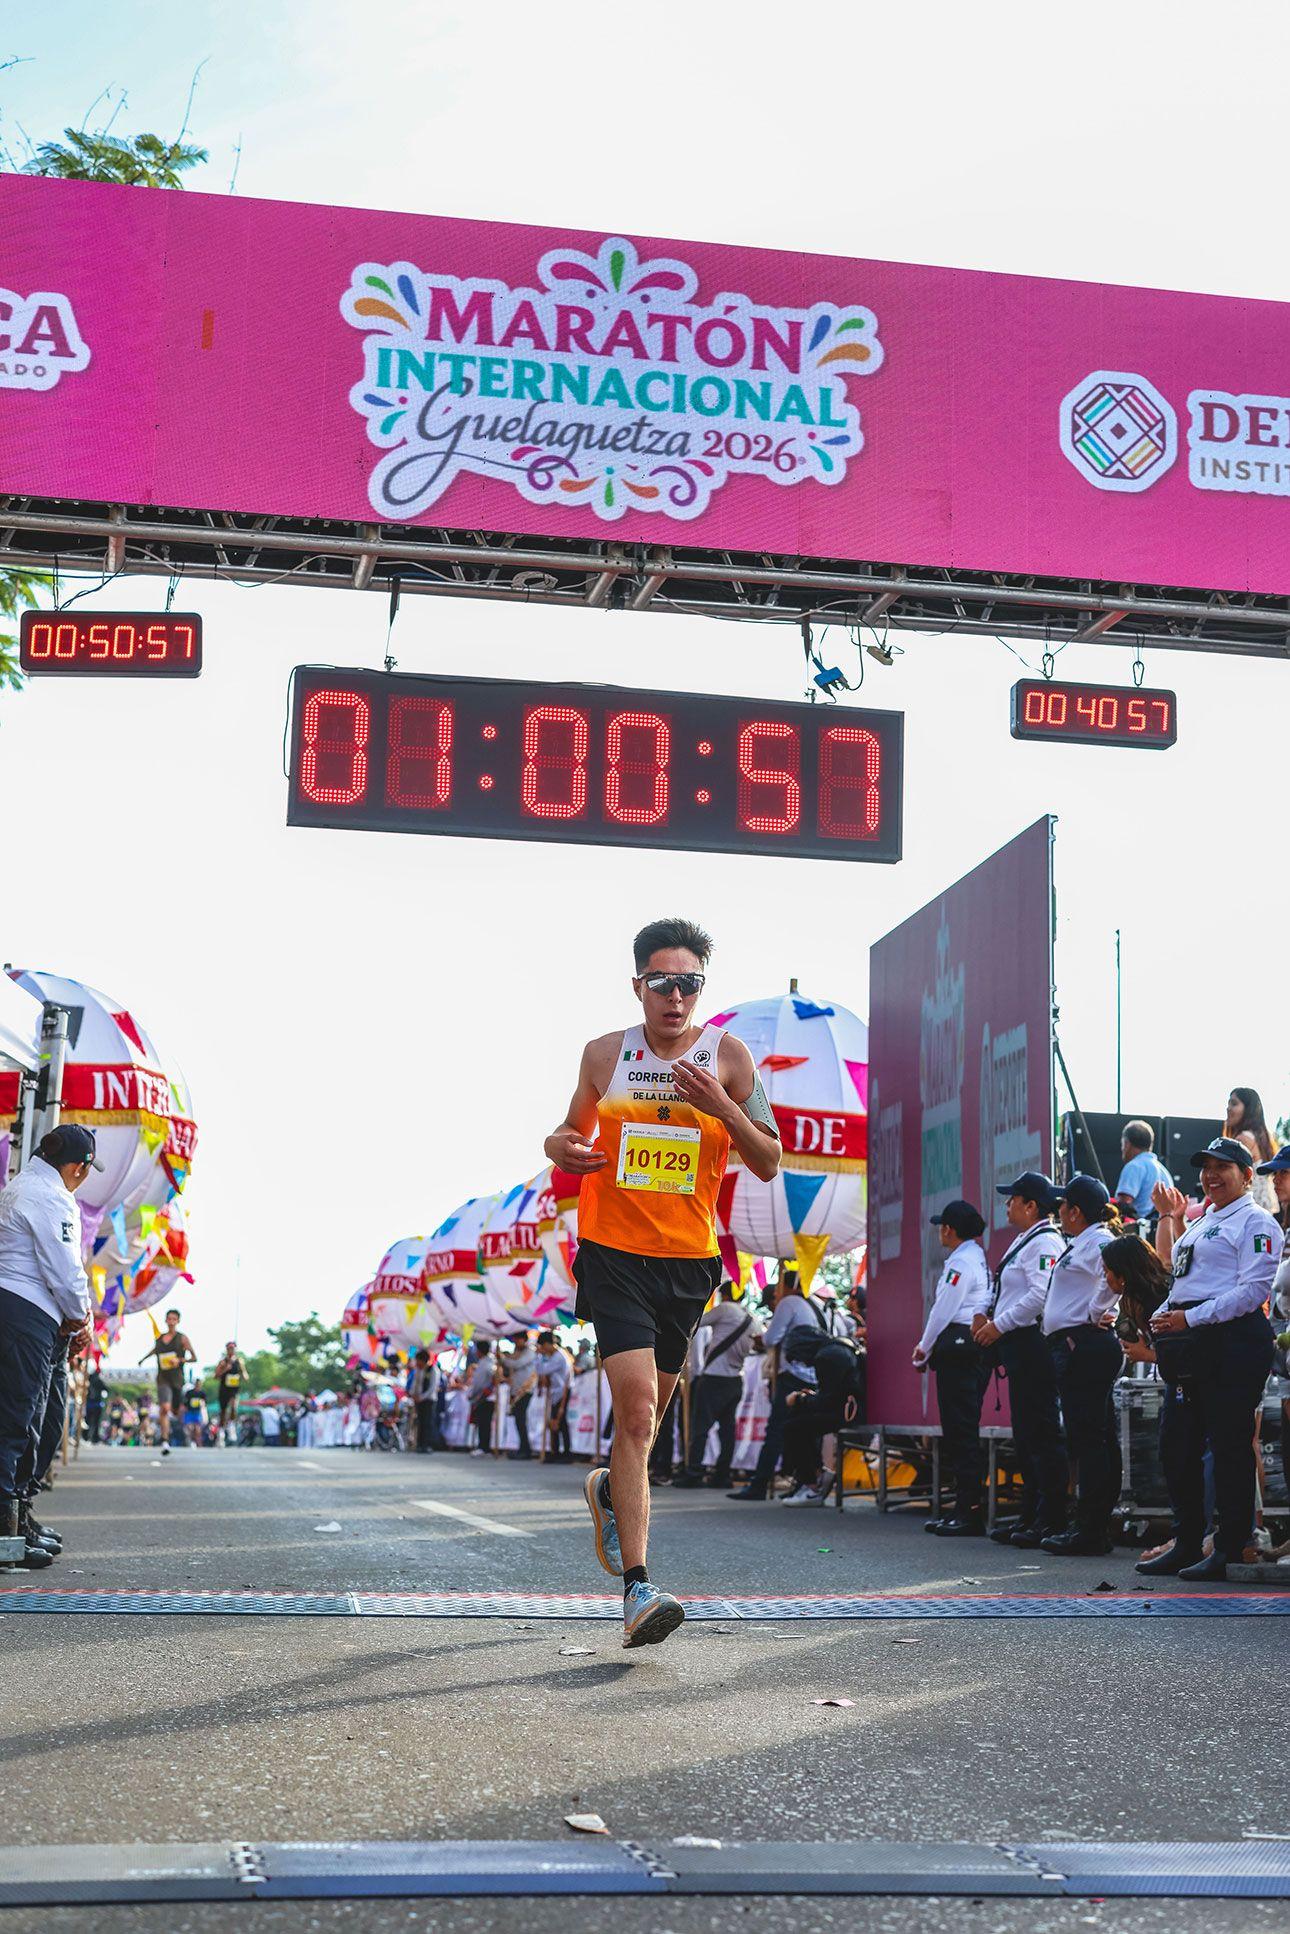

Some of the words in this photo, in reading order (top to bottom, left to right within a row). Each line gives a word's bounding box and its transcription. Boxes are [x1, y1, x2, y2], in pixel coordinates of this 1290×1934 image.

[425, 287, 804, 373] MARATÓN
[376, 347, 848, 428] INTERNACIONAL
[382, 378, 692, 505] Guelaguetza
[703, 430, 798, 472] 2026
[1199, 402, 1290, 449] DE
[30, 624, 193, 659] 00:50:57
[301, 691, 880, 832] 01:00:57
[628, 1071, 675, 1083] CORRED
[633, 1091, 644, 1100] DE
[645, 1092, 657, 1101] LA
[793, 1115, 846, 1155] DE
[626, 1148, 691, 1172] 10129
